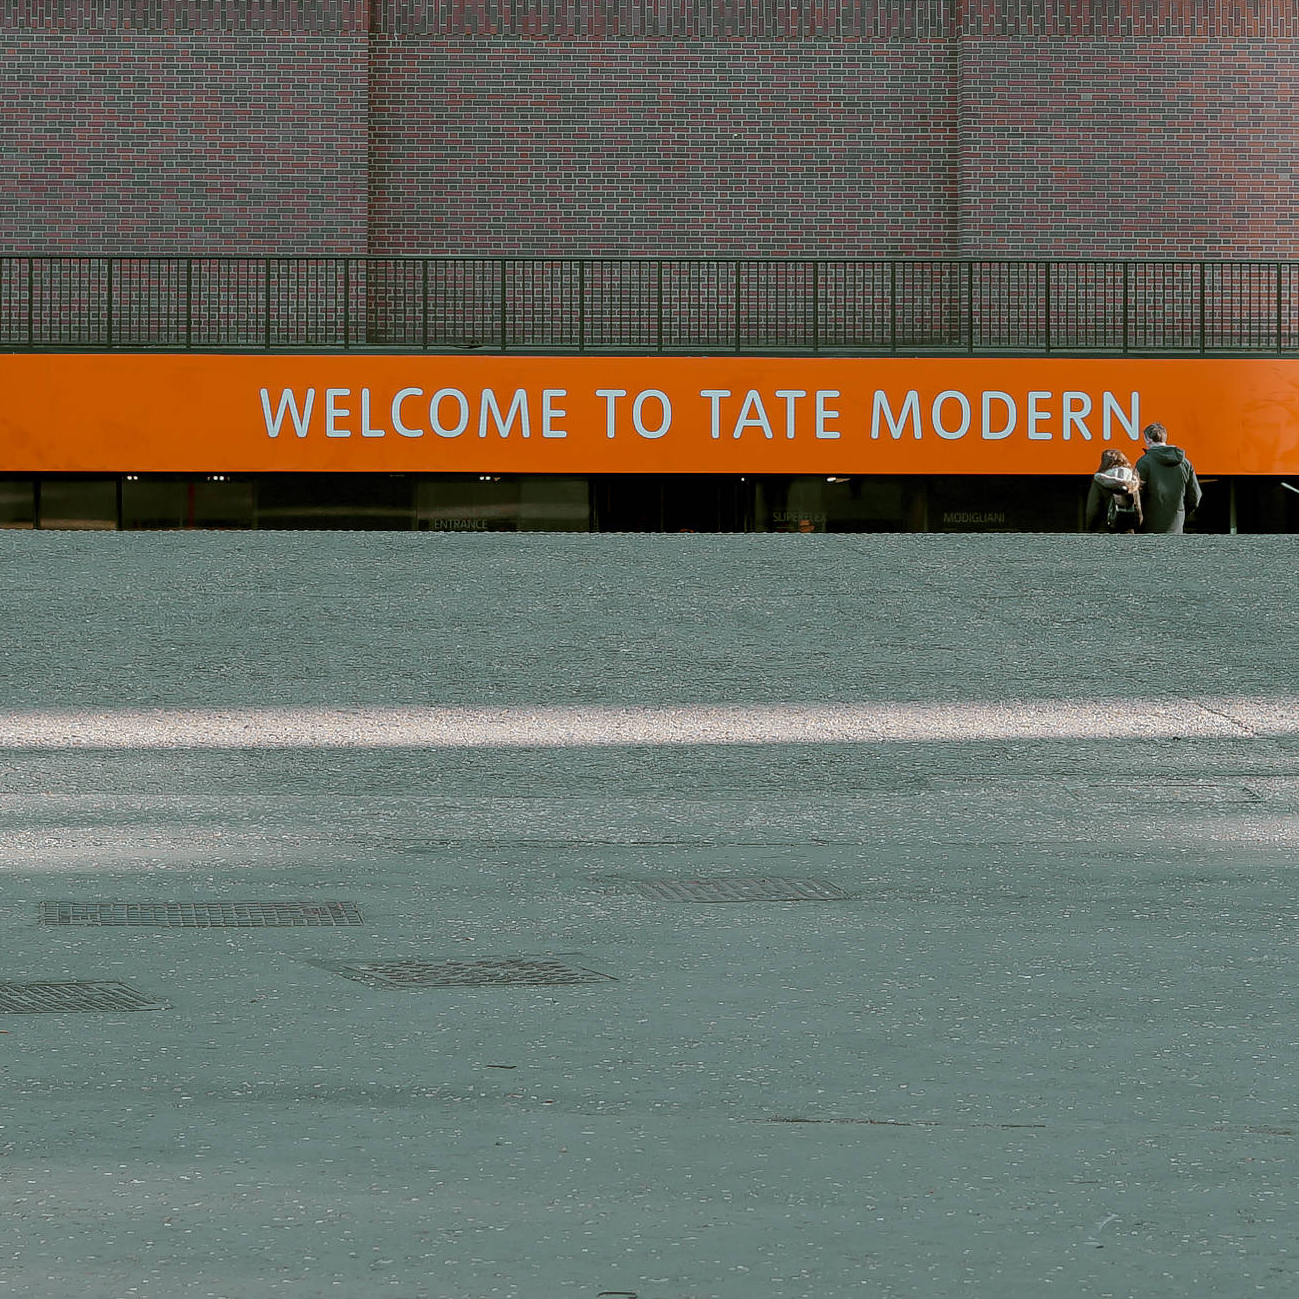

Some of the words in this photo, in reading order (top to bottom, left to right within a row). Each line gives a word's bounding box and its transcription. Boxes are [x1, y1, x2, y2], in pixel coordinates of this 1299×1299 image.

[258, 386, 569, 439] WELCOME
[594, 388, 673, 440] TO
[699, 388, 842, 440] TATE
[869, 389, 1141, 442] MODERN
[943, 512, 1005, 523] MODIGLIANI
[434, 519, 488, 529] ENTRANCE
